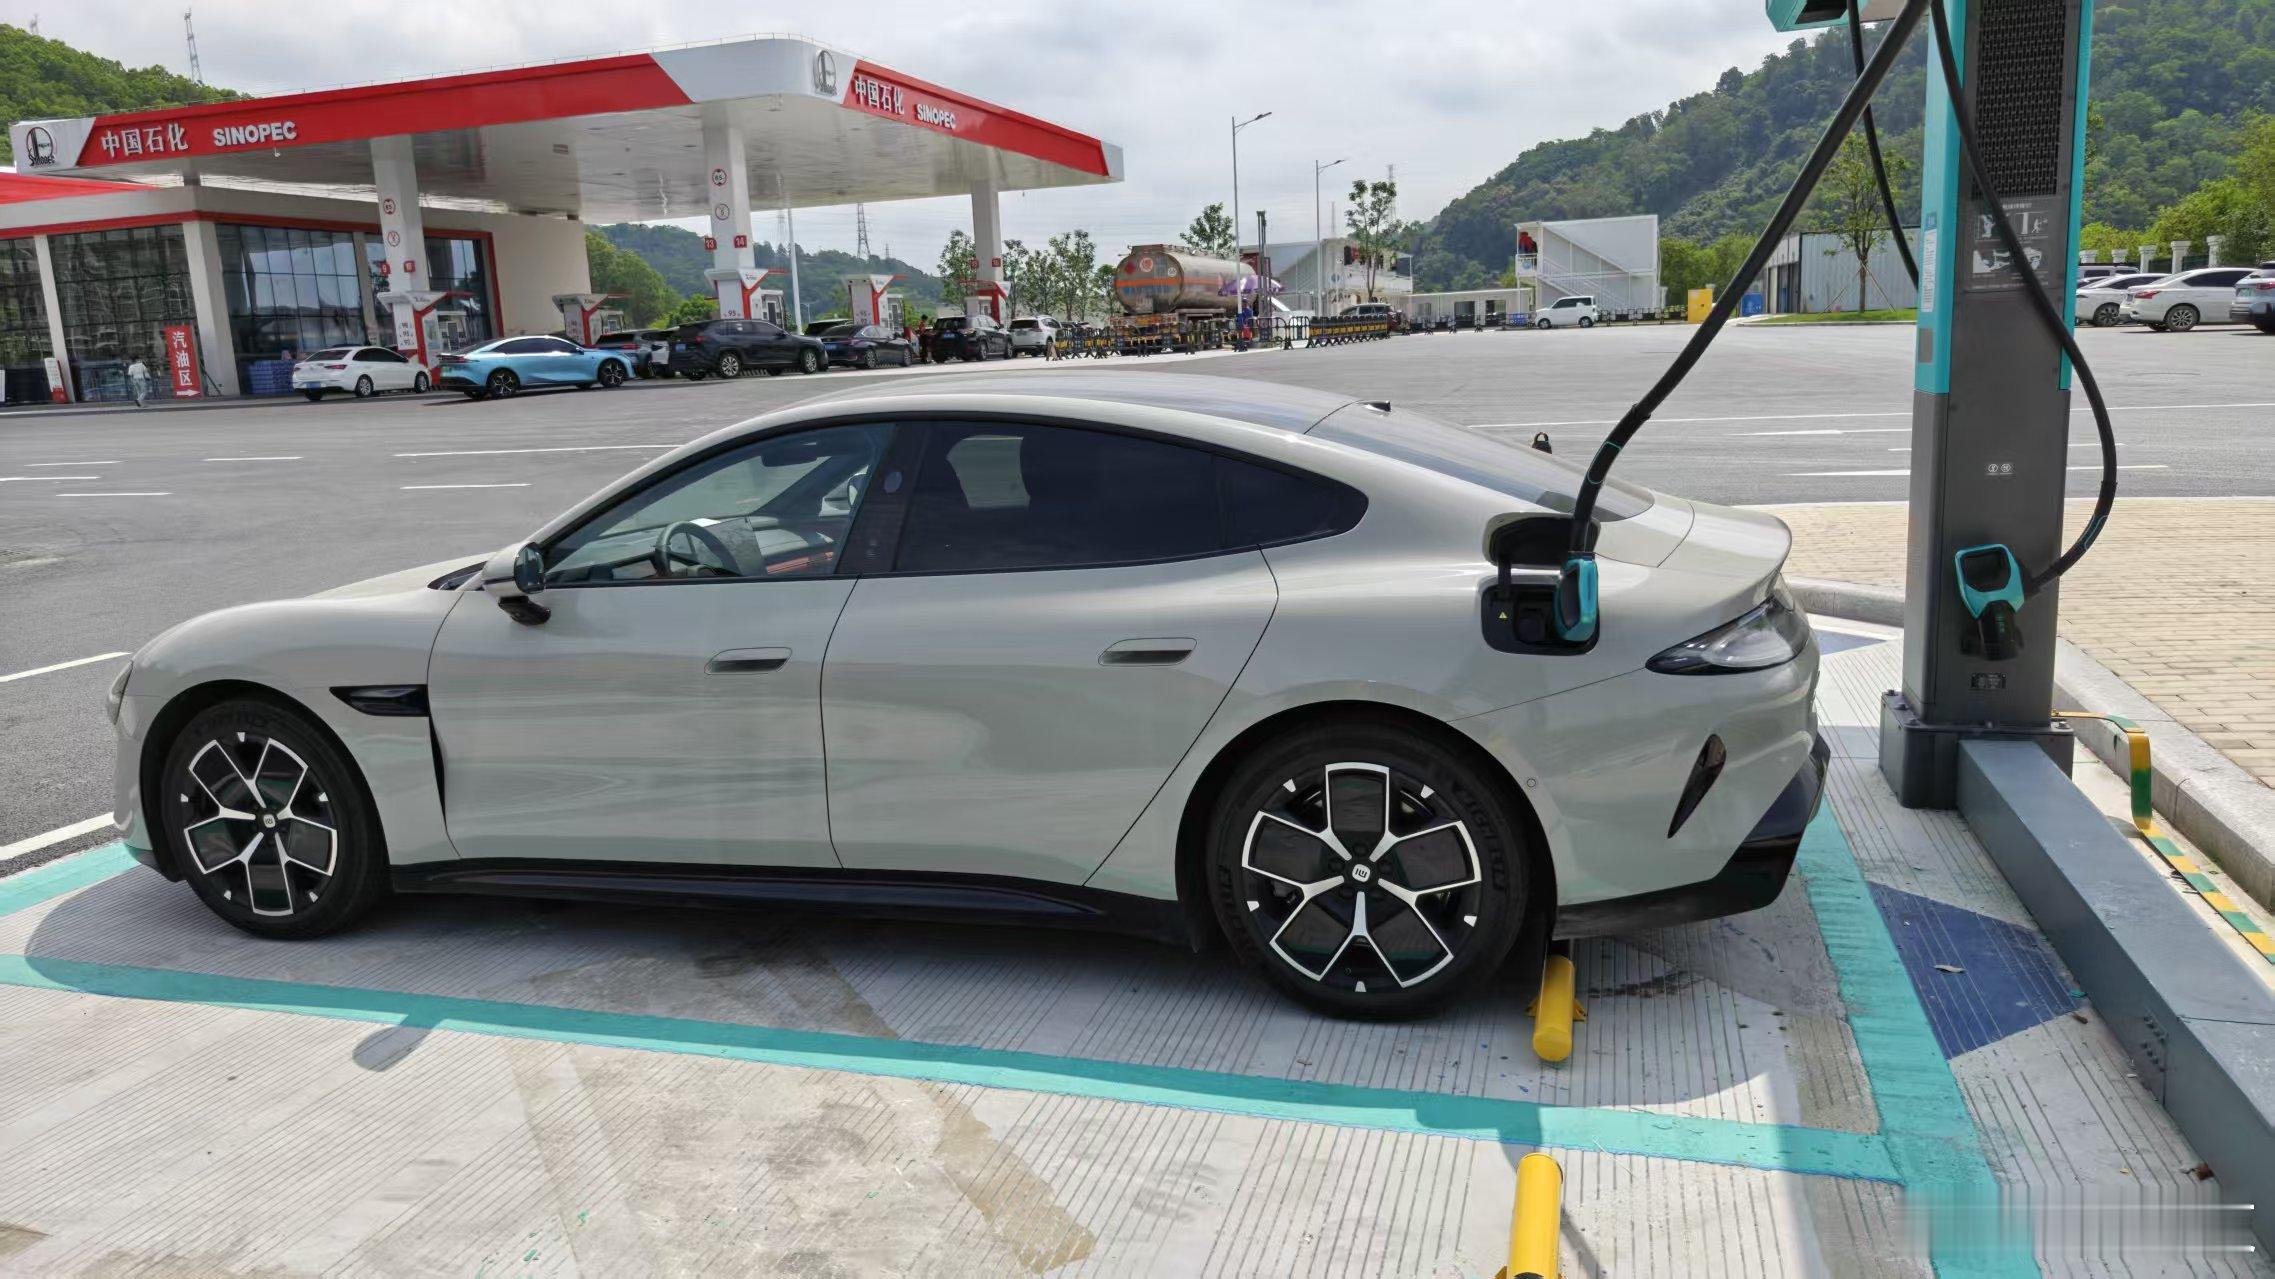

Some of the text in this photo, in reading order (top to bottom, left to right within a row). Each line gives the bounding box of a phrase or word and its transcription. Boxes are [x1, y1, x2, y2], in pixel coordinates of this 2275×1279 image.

[855, 74, 956, 129] 中国石化 SINOPEC
[100, 121, 297, 158] 中国石化 SINOPEC
[728, 309, 737, 317] 95
[172, 331, 193, 386] 汽油区
